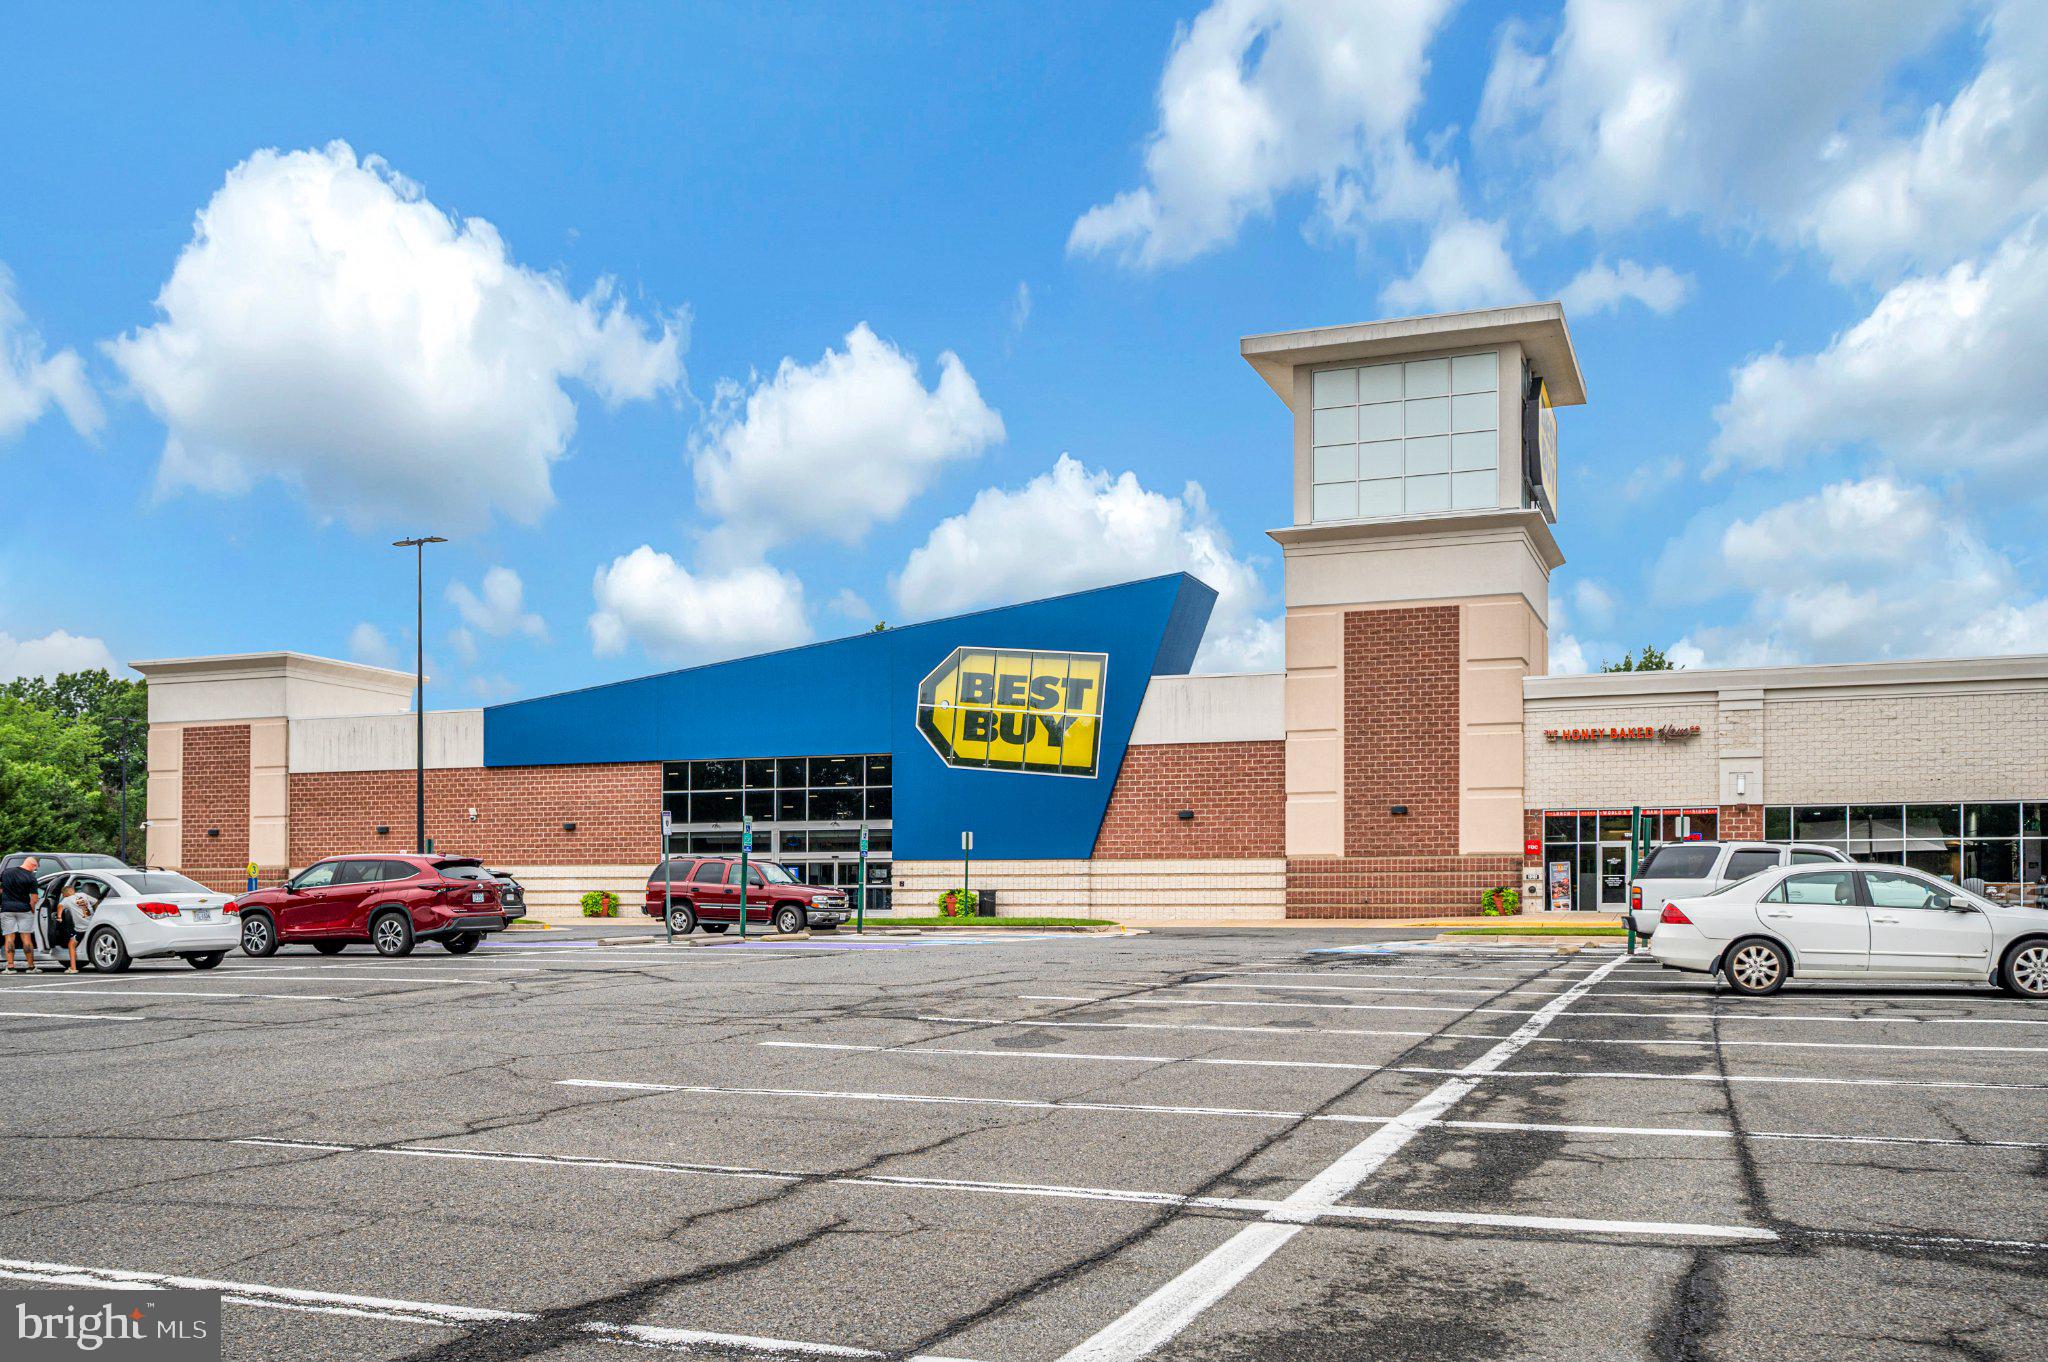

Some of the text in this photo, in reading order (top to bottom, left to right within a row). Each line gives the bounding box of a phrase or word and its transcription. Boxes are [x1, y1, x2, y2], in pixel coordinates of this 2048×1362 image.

[960, 672, 1094, 710] BEST
[963, 710, 1078, 747] BUY
[1562, 728, 1605, 741] HONEY
[1609, 726, 1655, 740] BAKED
[252, 866, 256, 874] 3
